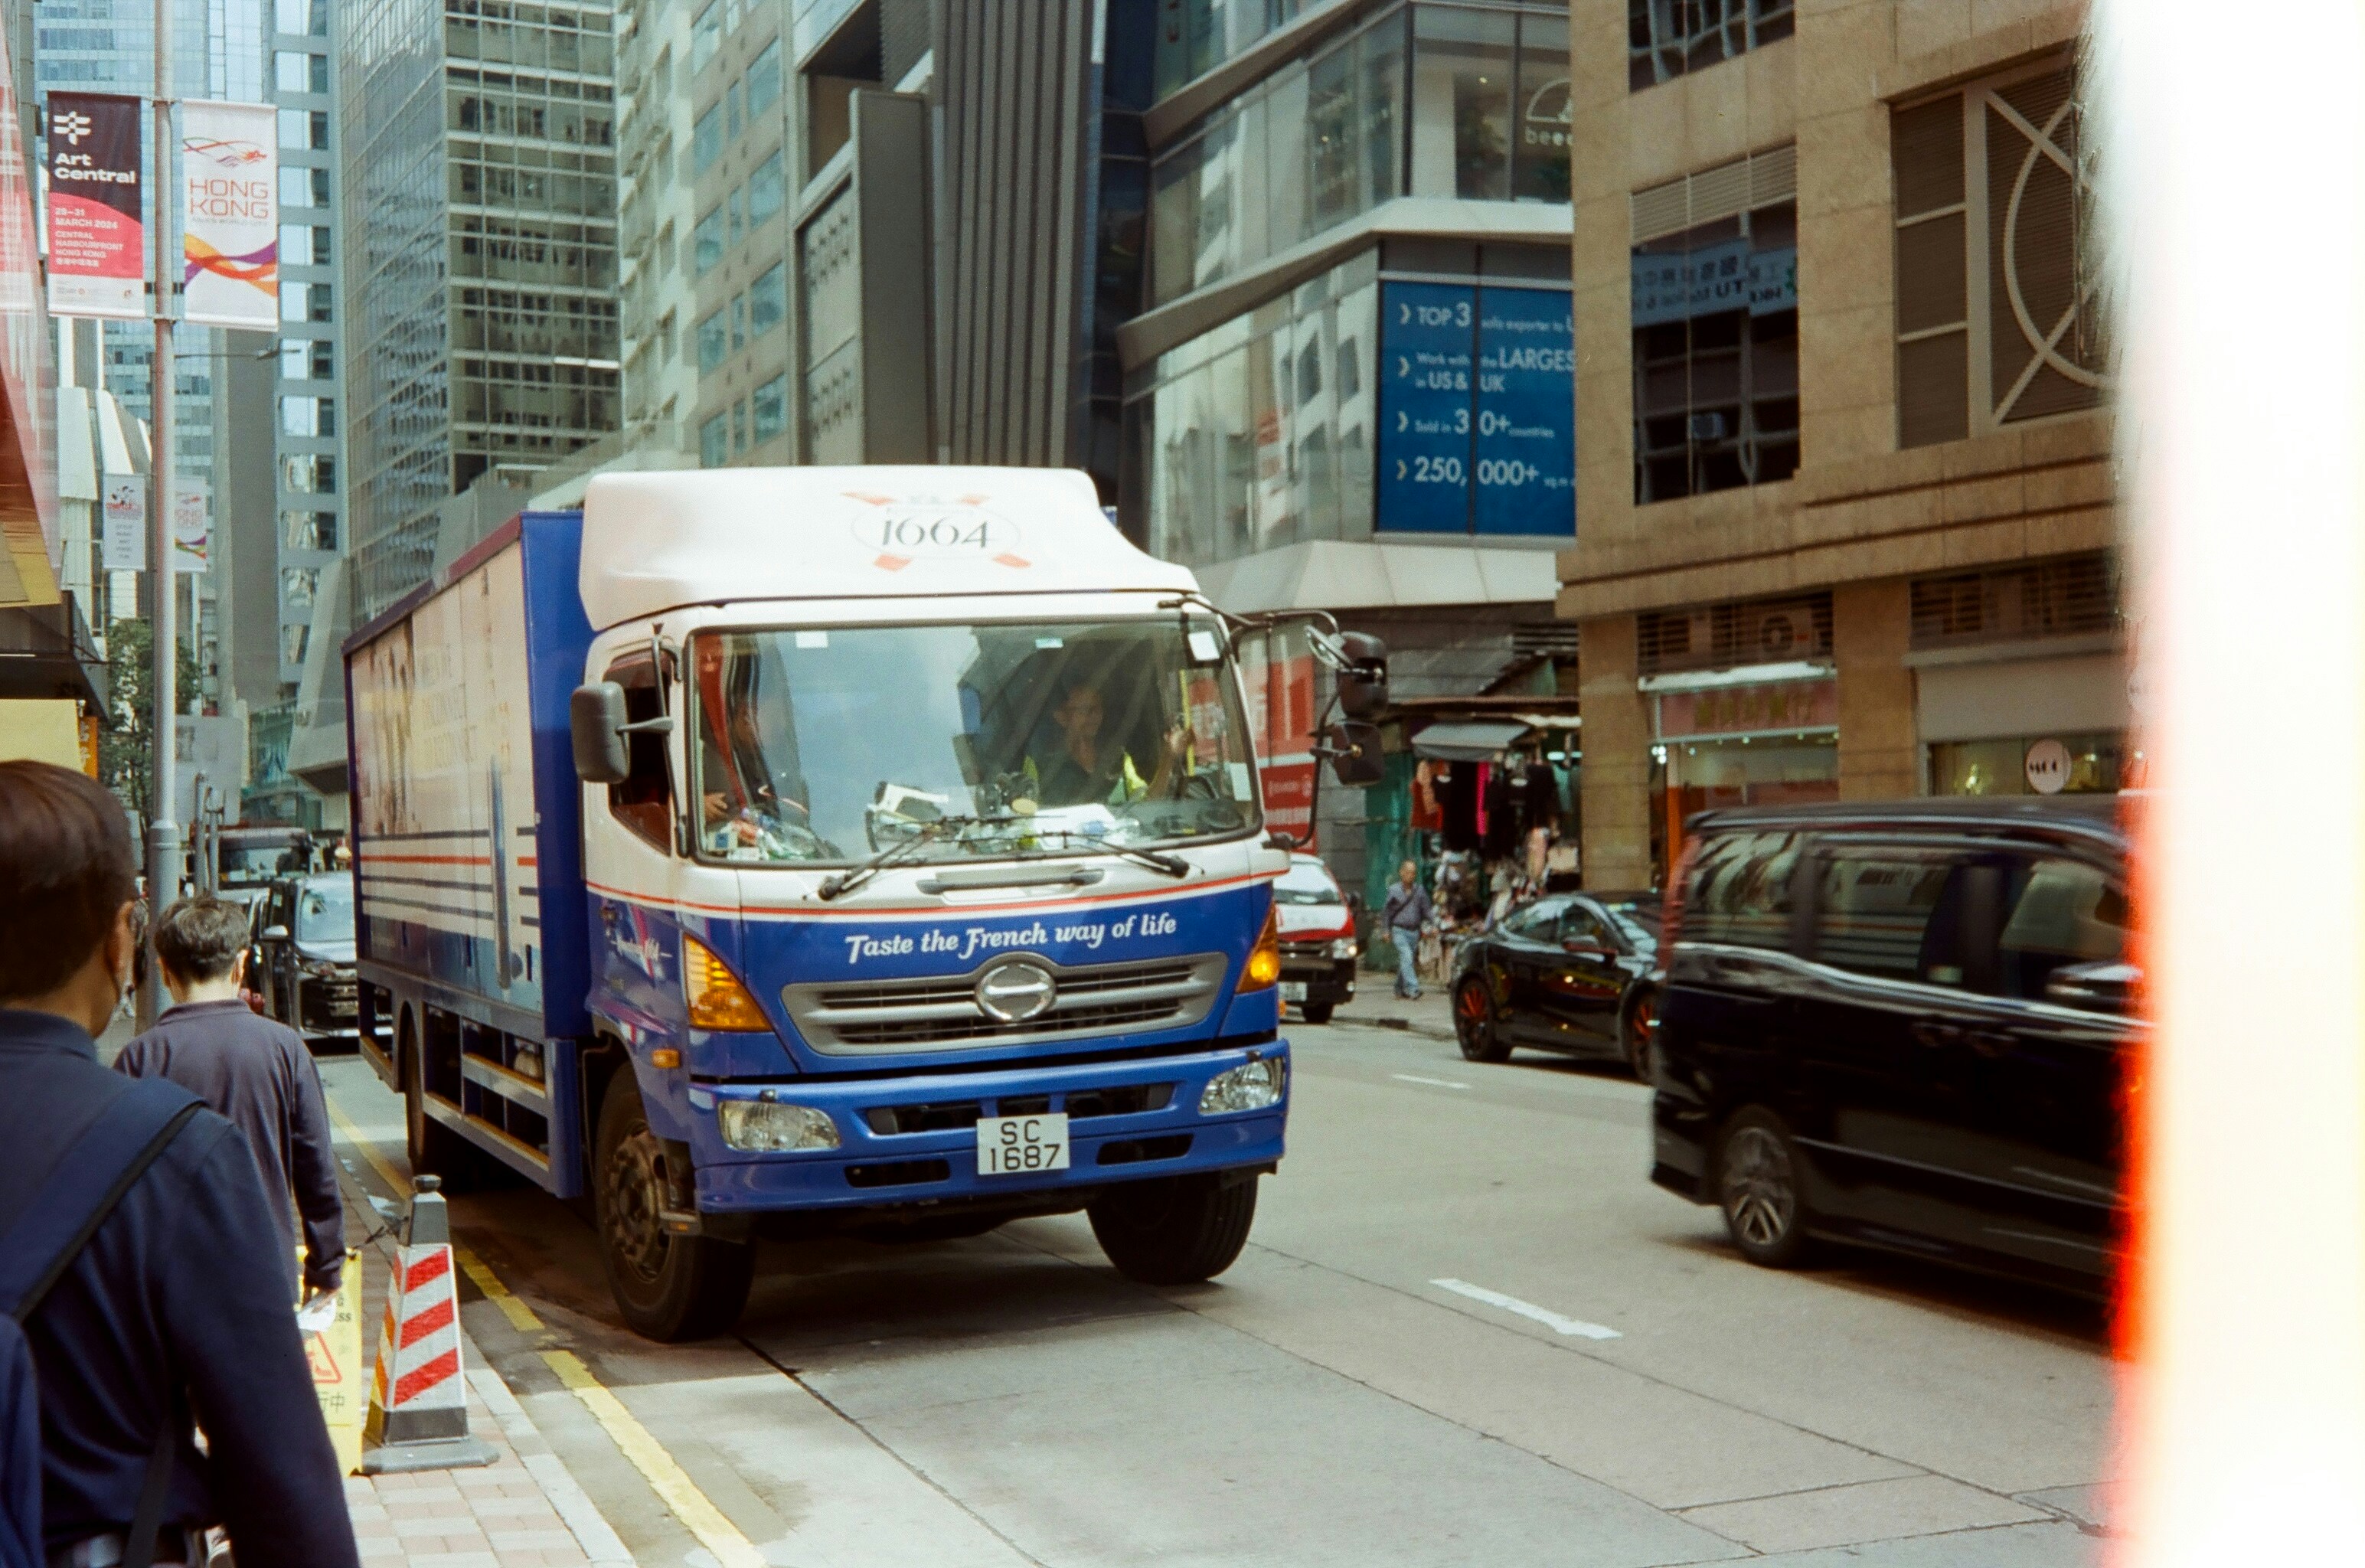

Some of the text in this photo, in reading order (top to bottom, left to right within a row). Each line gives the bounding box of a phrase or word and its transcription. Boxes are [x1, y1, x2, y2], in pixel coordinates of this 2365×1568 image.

[54, 152, 92, 166] Art
[54, 167, 136, 184] Central
[190, 178, 268, 199] HONG
[190, 197, 269, 219] KONG
[55, 217, 118, 230] MARCH 2024
[1418, 306, 1452, 326] TOP
[1455, 302, 1471, 328] 3
[1416, 352, 1445, 365] Work
[1448, 354, 1471, 366] with
[1428, 371, 1453, 390] US
[1455, 372, 1468, 390] &
[1480, 374, 1505, 392] UK
[1415, 420, 1439, 433] Sold
[882, 515, 992, 548] 1664
[845, 912, 1177, 964] Taste the French way of life
[1001, 1119, 1040, 1145] SC
[991, 1143, 1060, 1171] 1687
